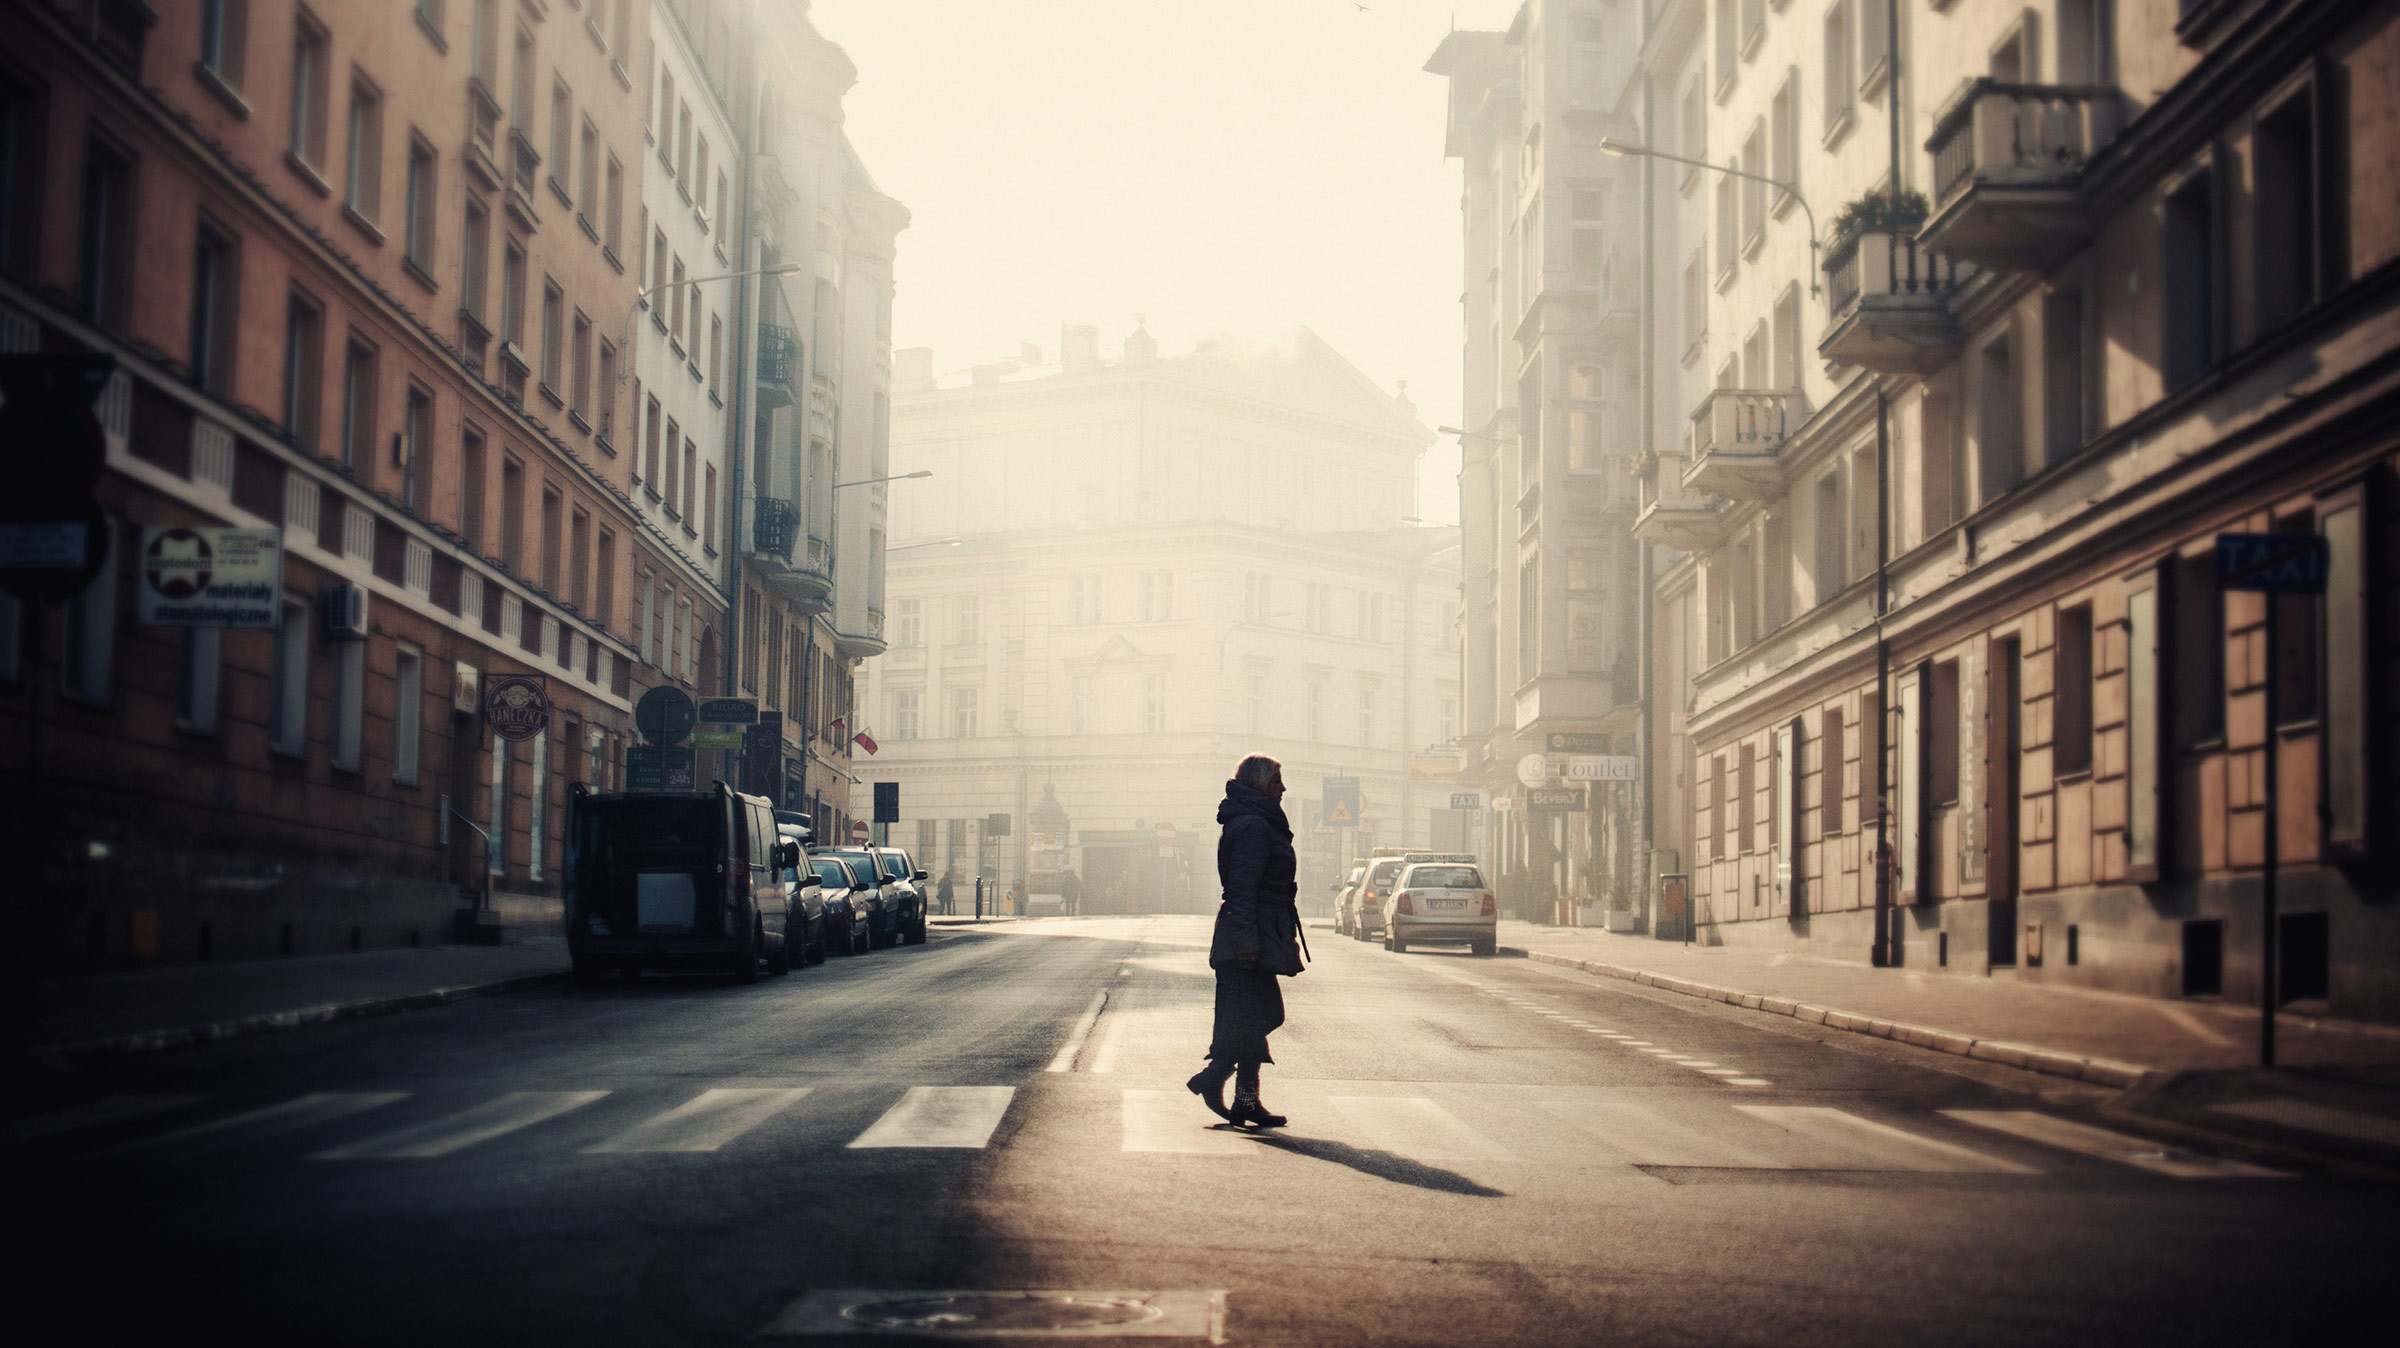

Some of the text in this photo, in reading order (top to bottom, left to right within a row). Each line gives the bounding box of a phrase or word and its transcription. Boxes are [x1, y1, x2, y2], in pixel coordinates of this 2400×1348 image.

[2220, 541, 2318, 582] TAXI
[206, 582, 273, 603] materiały
[155, 604, 272, 625] stomatologiczne
[489, 708, 542, 728] HANECZKA
[1572, 758, 1631, 778] outlet
[1965, 656, 1975, 879] TOREBEK
[668, 774, 691, 785] 24h
[1451, 795, 1479, 807] TAXI
